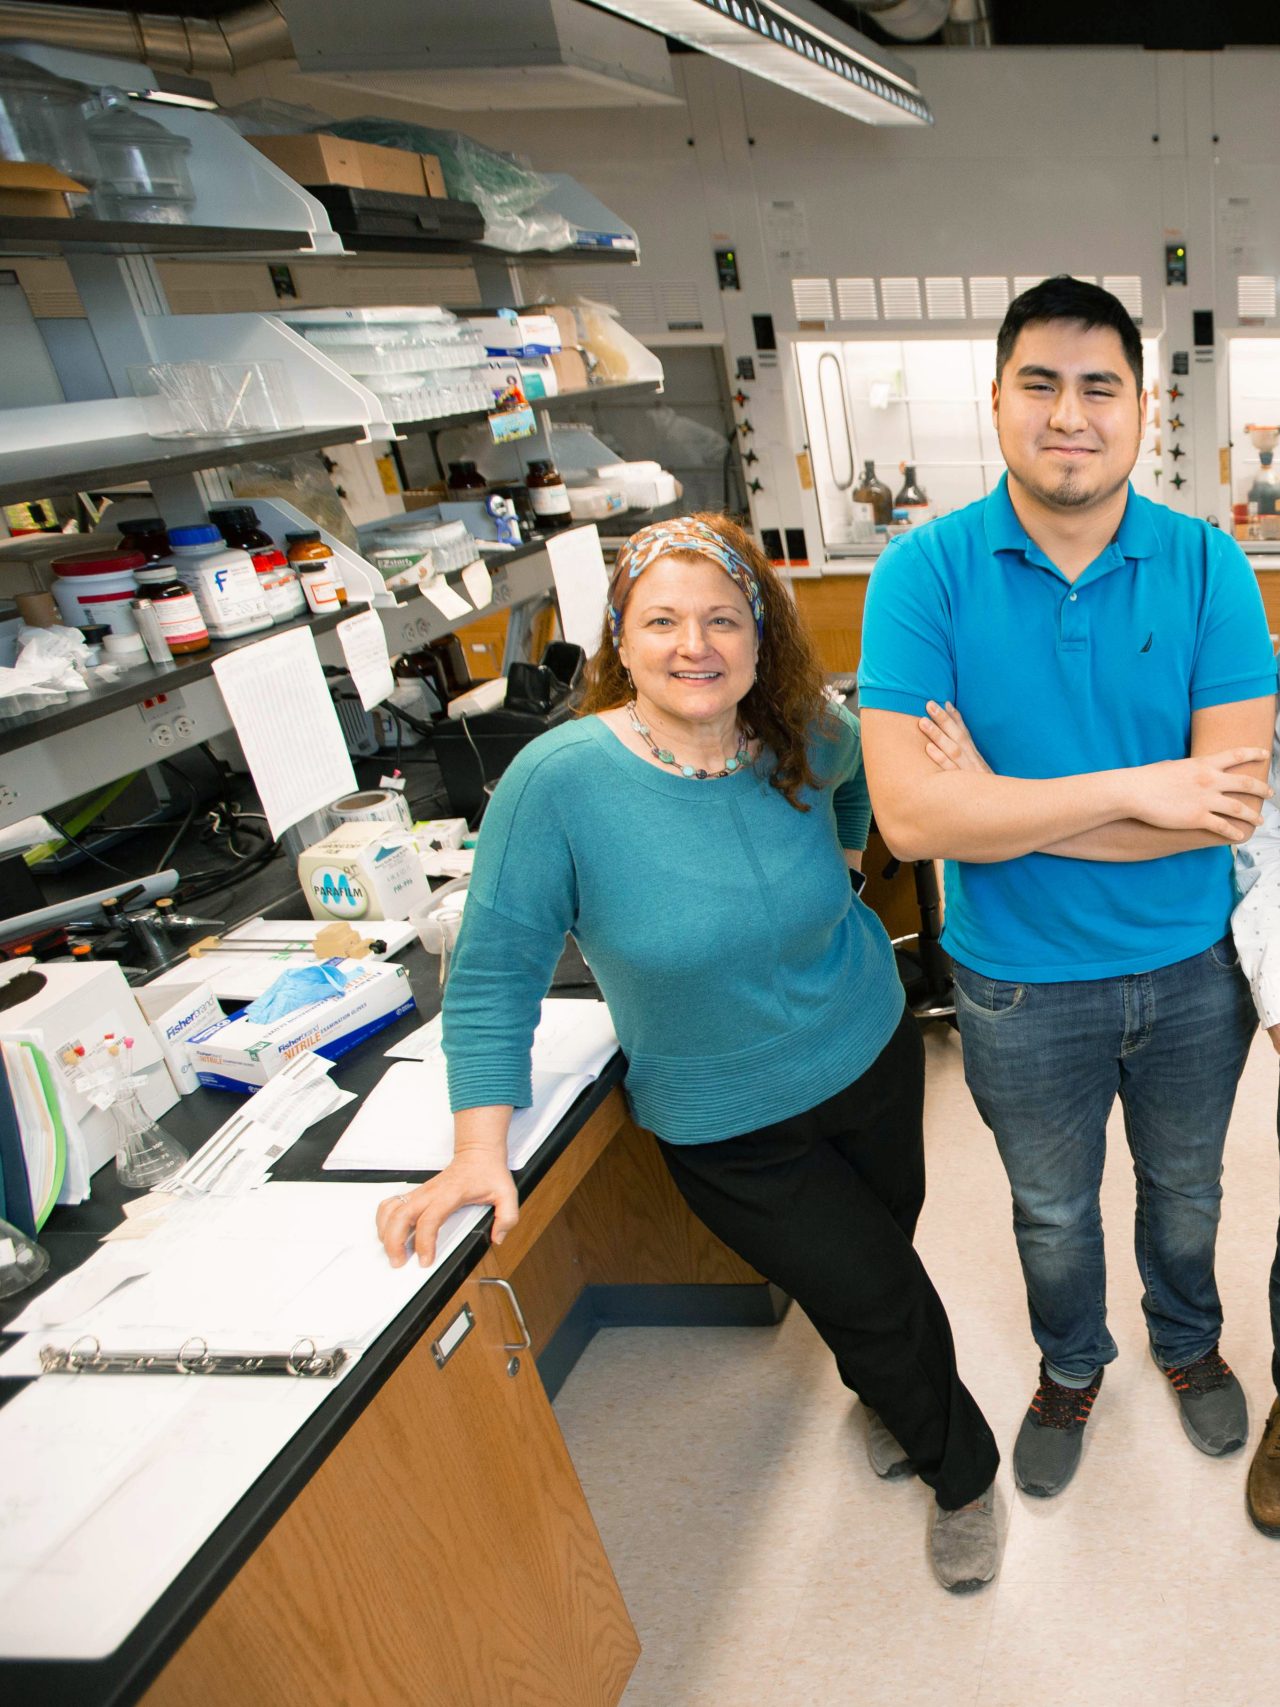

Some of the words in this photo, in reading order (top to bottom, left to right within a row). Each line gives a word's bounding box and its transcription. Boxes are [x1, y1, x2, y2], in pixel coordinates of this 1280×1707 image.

[215, 570, 228, 592] F
[313, 886, 363, 898] PARAFILM
[166, 992, 215, 1040] Fisherbrand
[278, 1025, 319, 1053] Fisherbrand
[284, 1031, 322, 1061] NITRILE
